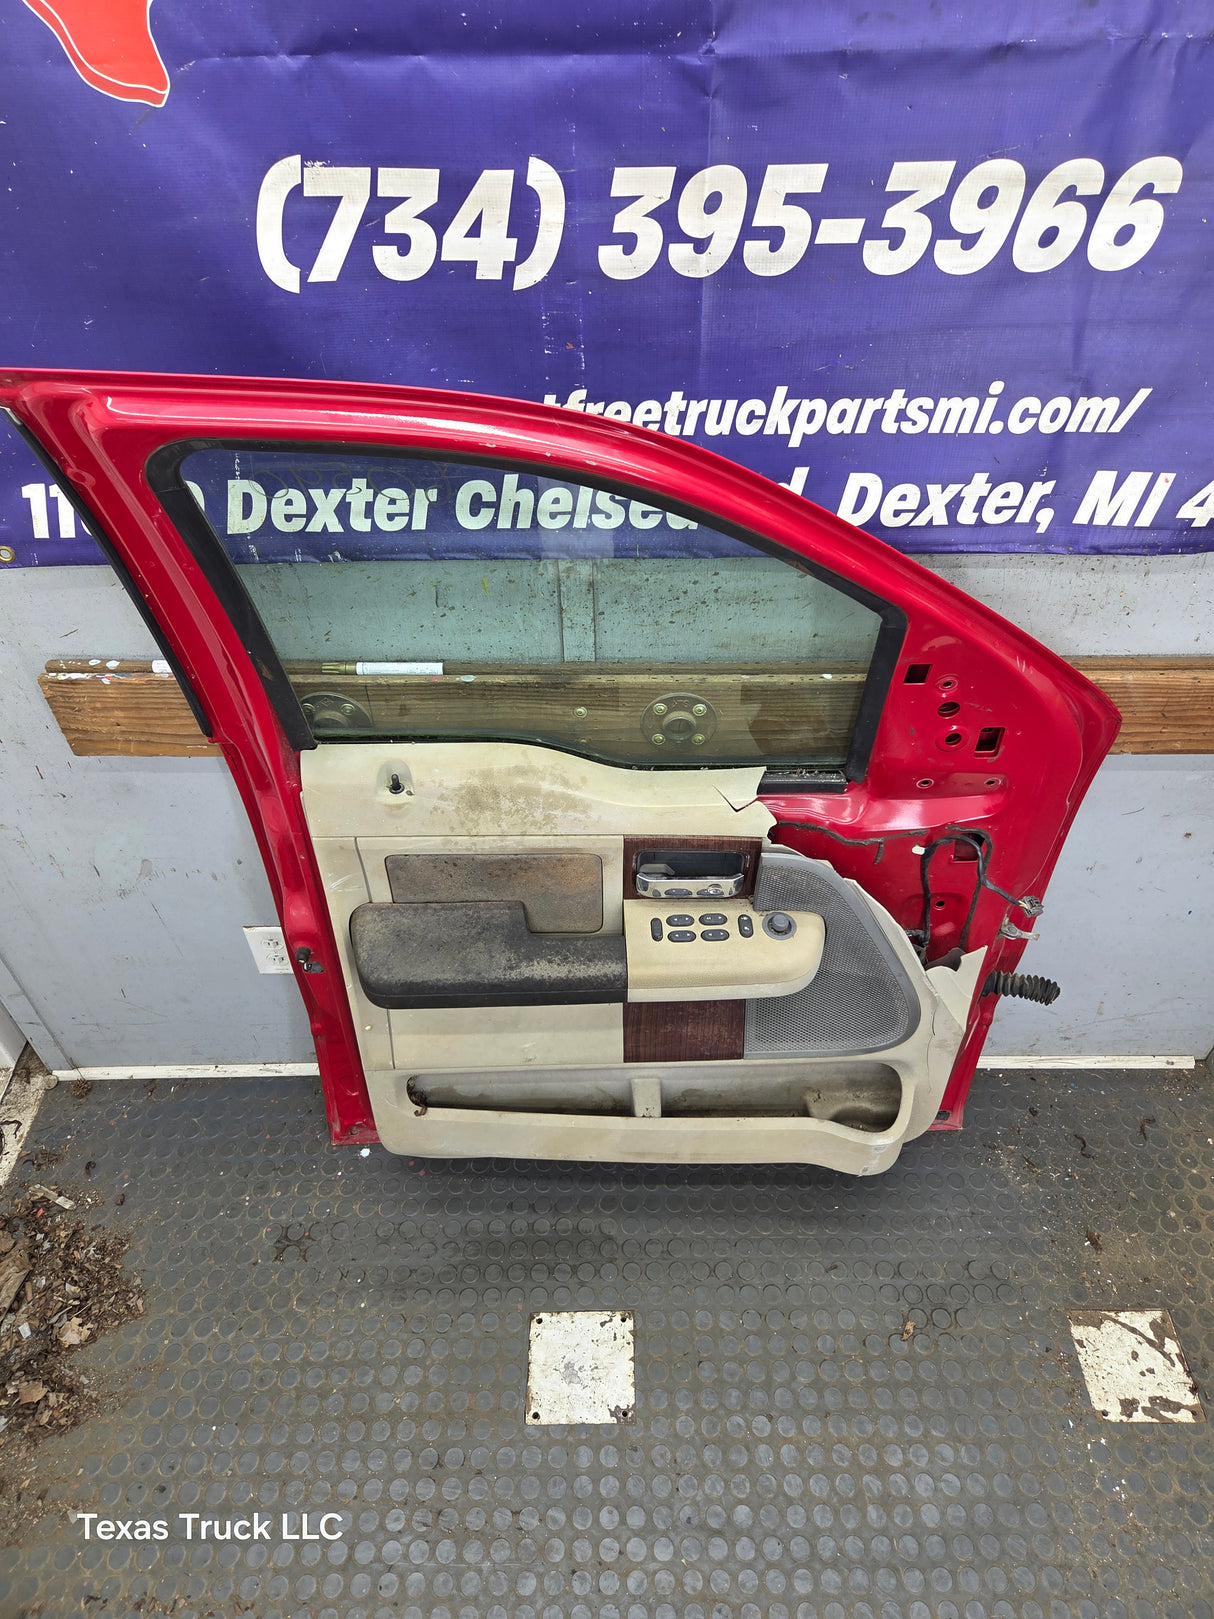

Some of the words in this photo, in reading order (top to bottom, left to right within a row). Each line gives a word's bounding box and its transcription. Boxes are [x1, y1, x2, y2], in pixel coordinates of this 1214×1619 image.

[256, 154, 566, 294] (734)
[597, 156, 1184, 281] 395-3966
[539, 381, 1154, 448] eetruckpartsmi.com/
[227, 477, 438, 535] Dexter
[836, 473, 1057, 534] Dexter,
[1072, 470, 1177, 528] MI
